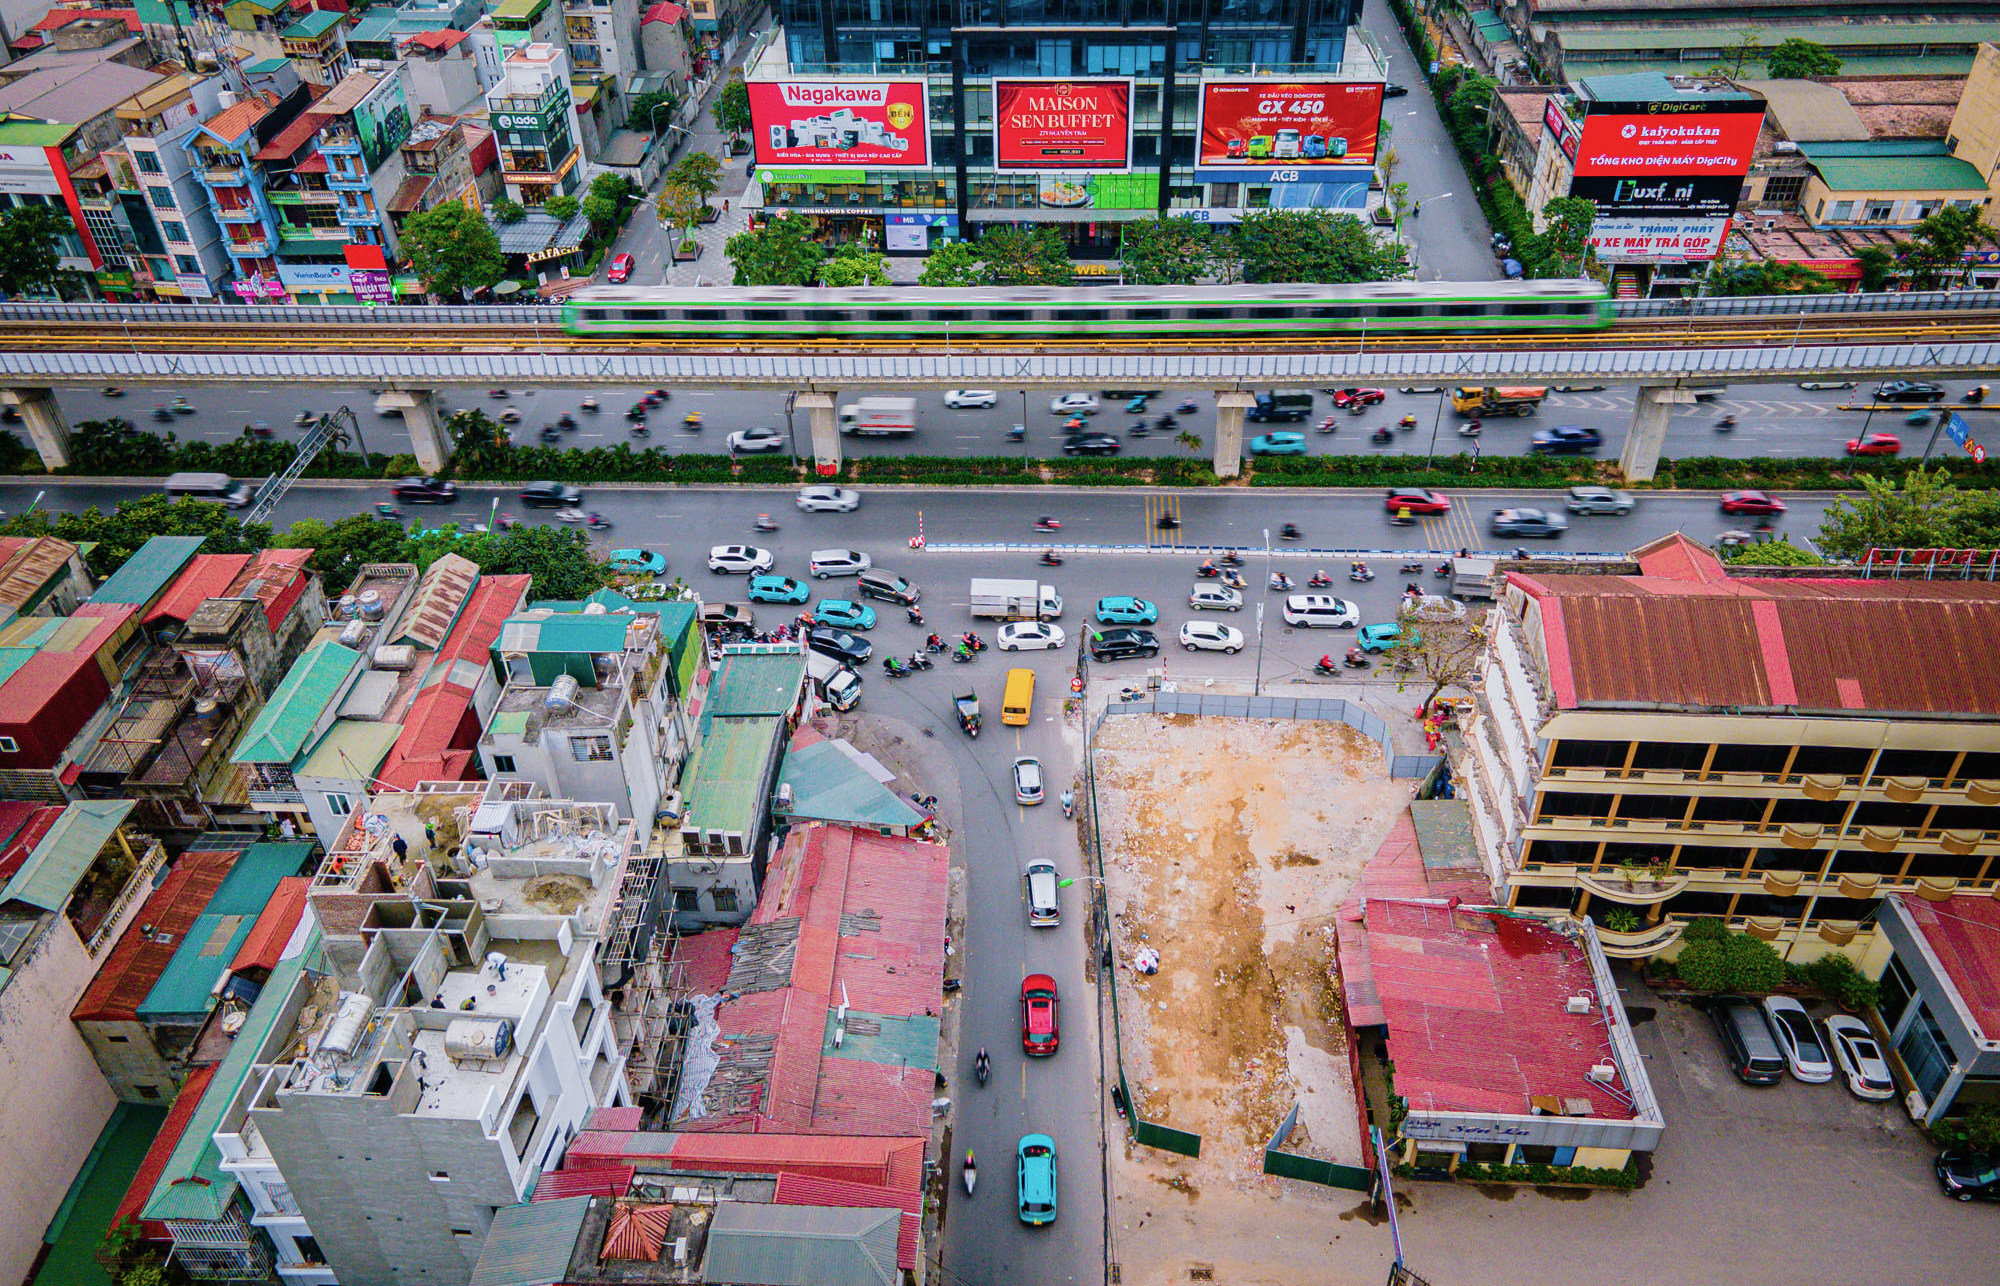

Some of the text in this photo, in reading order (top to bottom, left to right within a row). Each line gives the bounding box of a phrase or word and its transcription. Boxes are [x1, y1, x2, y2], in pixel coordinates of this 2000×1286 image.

[788, 85, 881, 104] Nagakawa
[1029, 97, 1098, 111] MAISON
[1258, 100, 1325, 115] GX 450
[1011, 114, 1115, 128] SEN BUFFET
[1641, 125, 1720, 139] kaiyokukan
[1621, 156, 1644, 166] KHO
[1645, 154, 1671, 167] ĐIỆN
[1672, 154, 1695, 165] MÁY
[1696, 156, 1738, 167] DigiCity
[1269, 170, 1299, 182] ACB
[902, 216, 914, 224] MB
[1184, 210, 1209, 221] ACB
[1604, 237, 1621, 248] XE
[1624, 235, 1652, 248] MÁY
[1656, 234, 1681, 248] TRẢ
[1684, 235, 1711, 248] GÓP
[527, 247, 560, 263] KAFA
[294, 271, 333, 279] VietinBank
